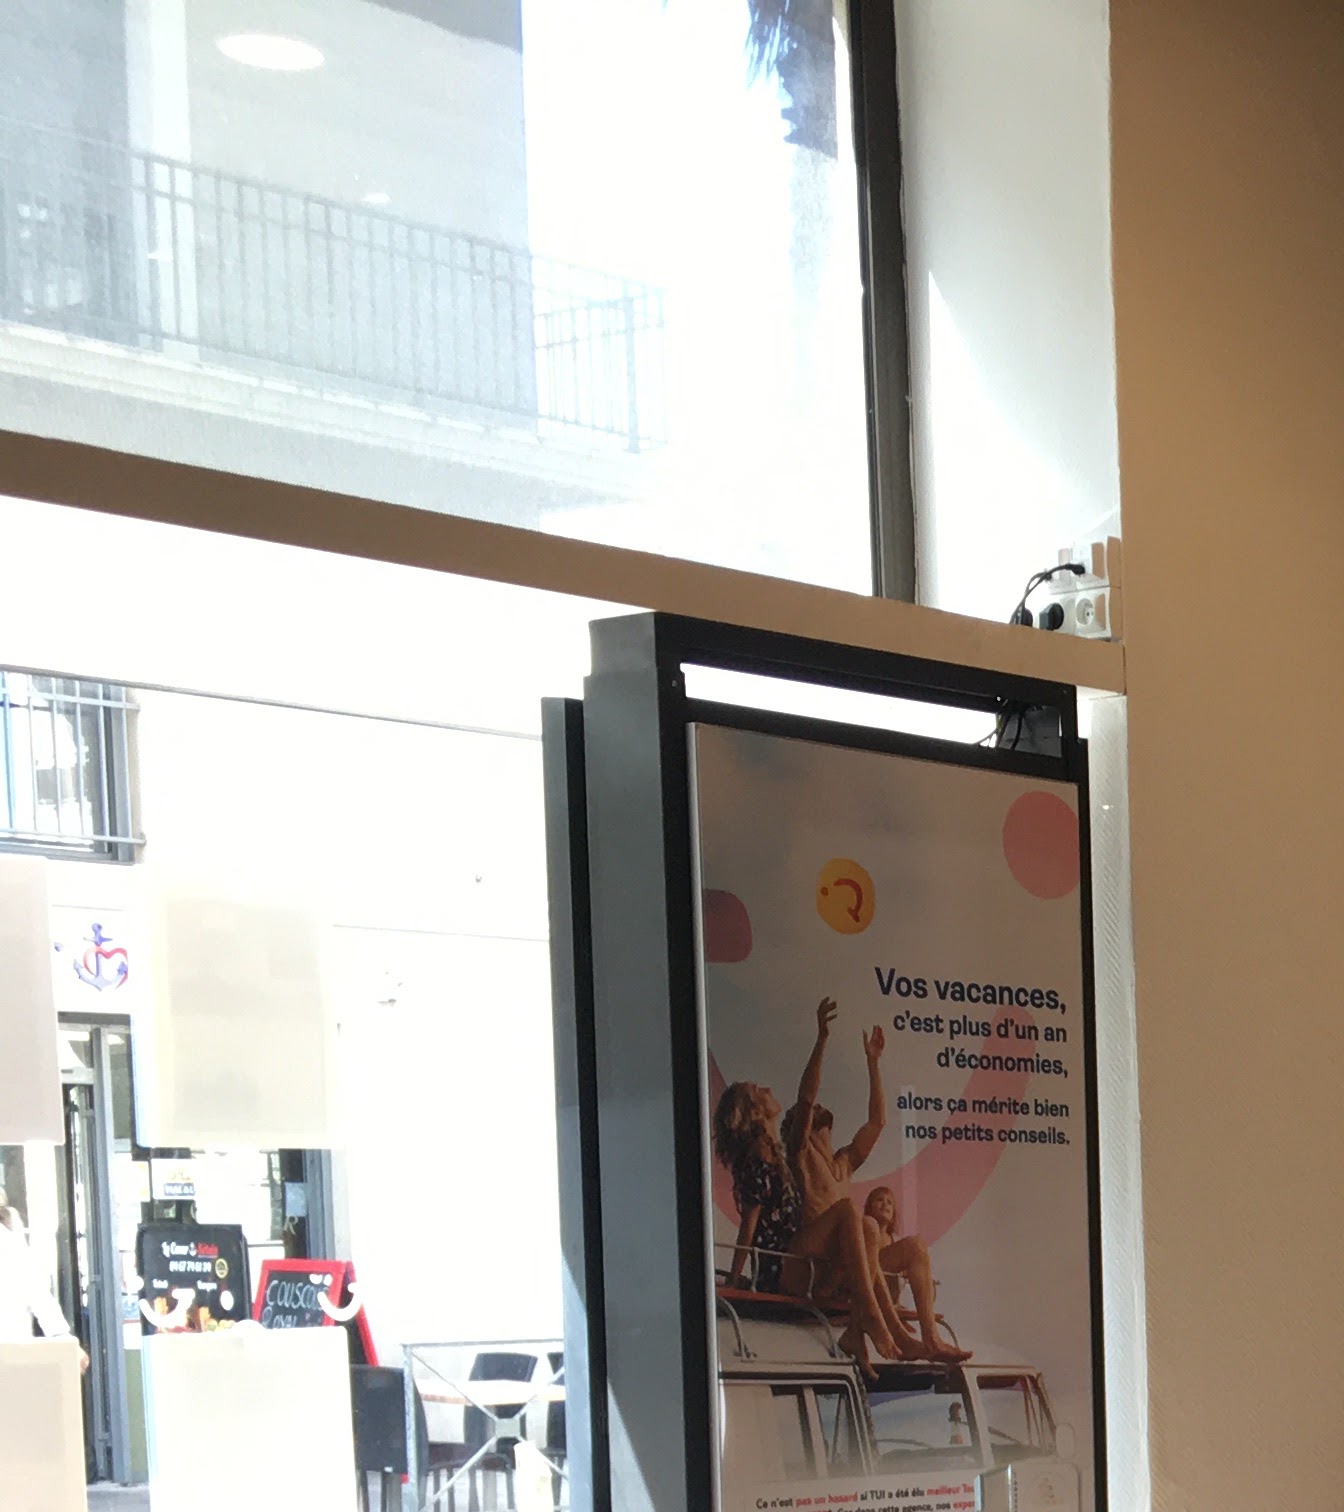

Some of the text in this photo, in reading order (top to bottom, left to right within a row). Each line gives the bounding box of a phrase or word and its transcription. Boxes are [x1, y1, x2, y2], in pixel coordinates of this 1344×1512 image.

[875, 967, 1067, 1014] Vos vacances,
[893, 1013, 1067, 1043] c'est plus d'un an
[936, 1047, 1069, 1078] d'économies,
[897, 1093, 1069, 1118] alors ça mérite bien
[905, 1125, 1071, 1146] nos petits conseils.
[266, 1280, 329, 1311] COUSCOU
[755, 1498, 769, 1510] Ce
[869, 1489, 885, 1501] TUI
[926, 1484, 960, 1496] meilleur
[936, 1501, 951, 1511] nos
